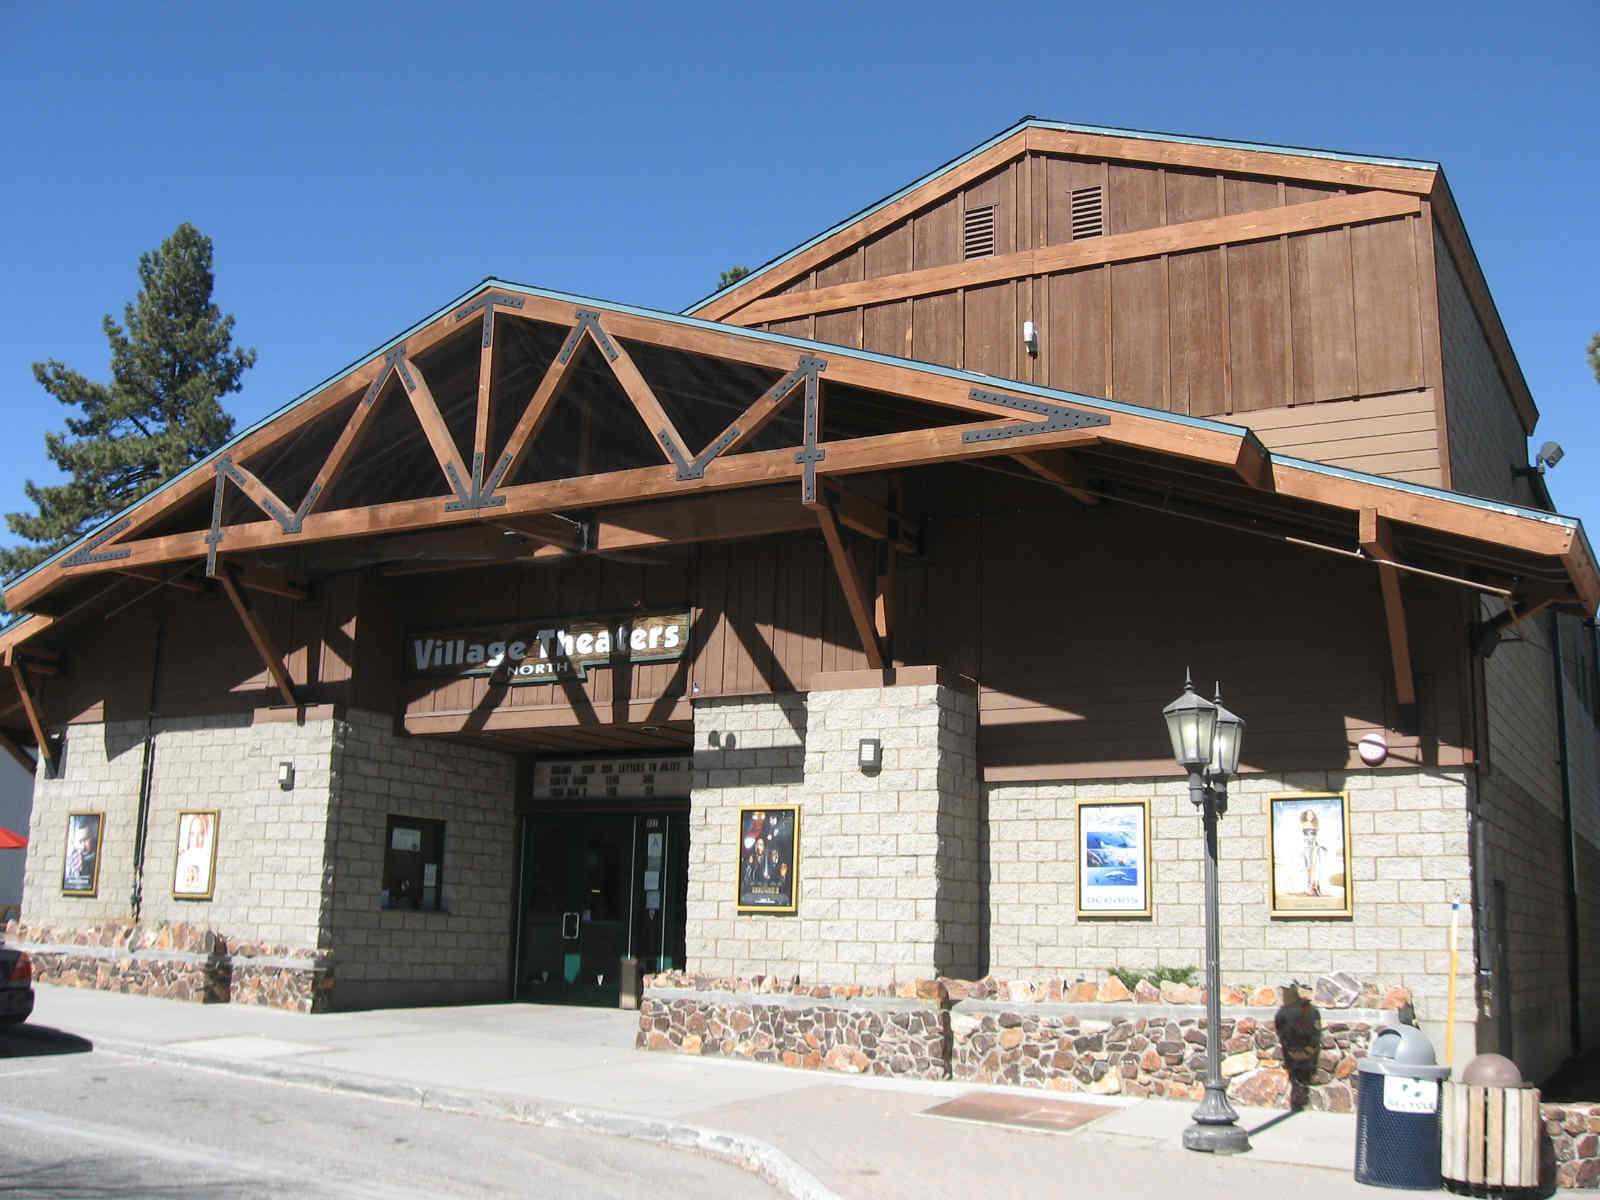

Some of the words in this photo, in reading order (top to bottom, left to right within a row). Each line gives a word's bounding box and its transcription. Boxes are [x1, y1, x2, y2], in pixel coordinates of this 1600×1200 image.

[414, 639, 527, 671] Village
[536, 624, 681, 658] Theaters
[507, 662, 568, 676] NORTH
